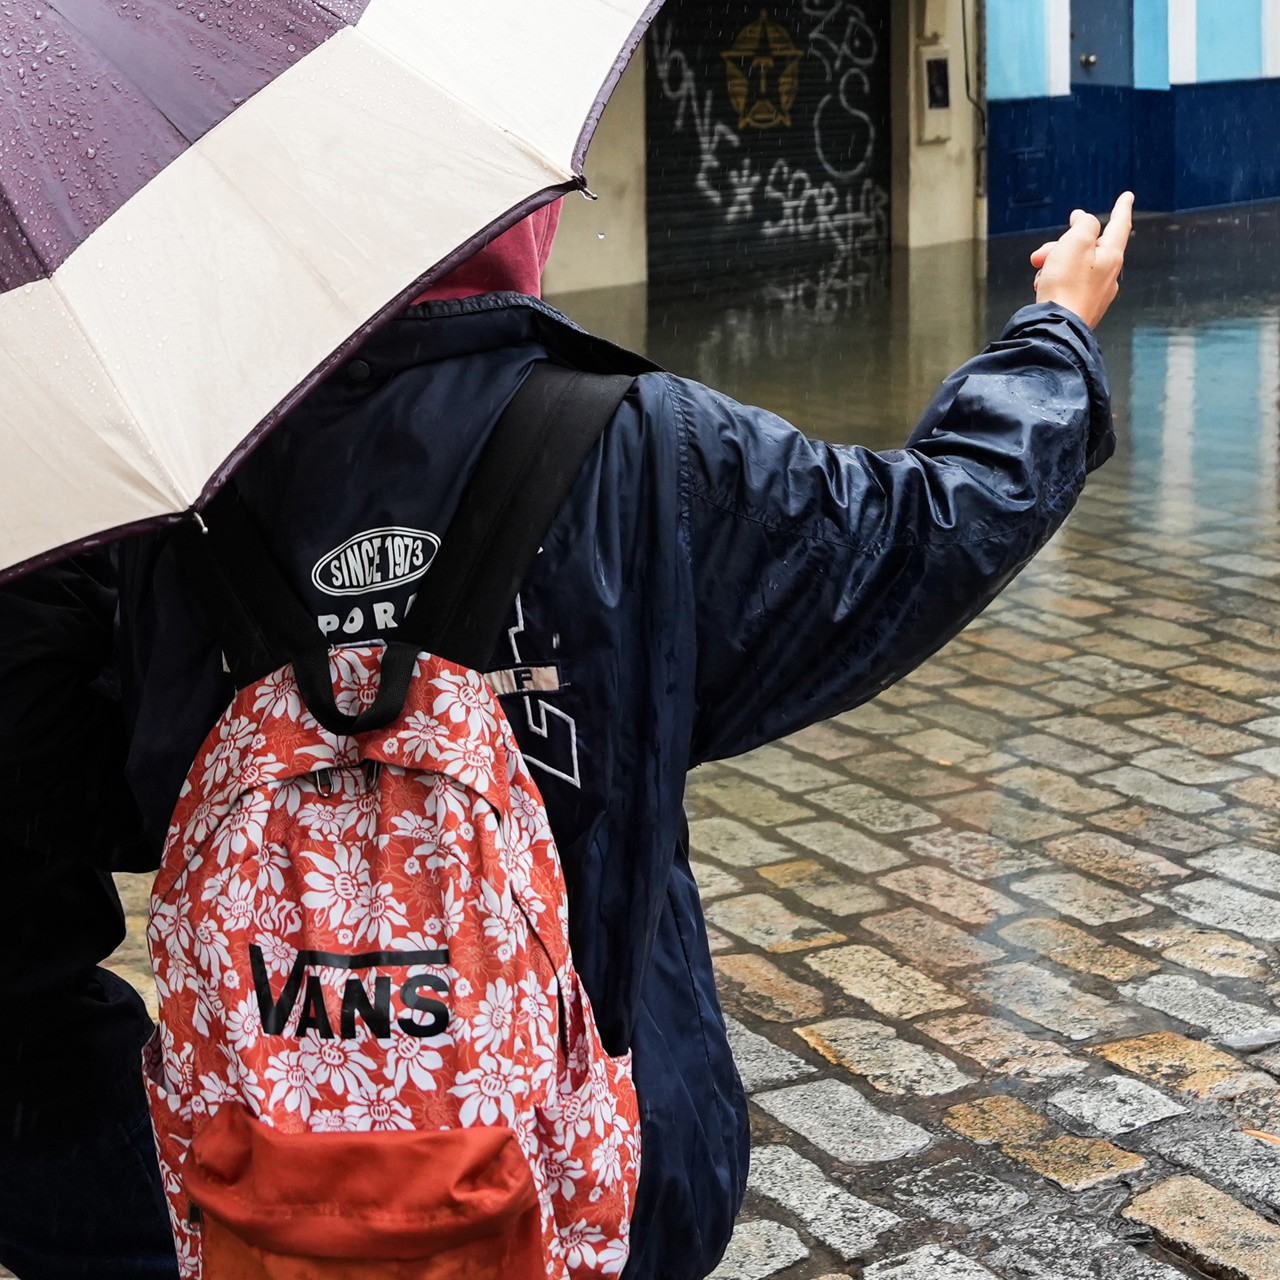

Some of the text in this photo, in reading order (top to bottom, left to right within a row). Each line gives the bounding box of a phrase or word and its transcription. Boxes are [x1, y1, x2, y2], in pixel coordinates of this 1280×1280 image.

[330, 535, 424, 587] SINCE 1973
[317, 591, 418, 638] POR
[248, 943, 450, 1039] VANS
